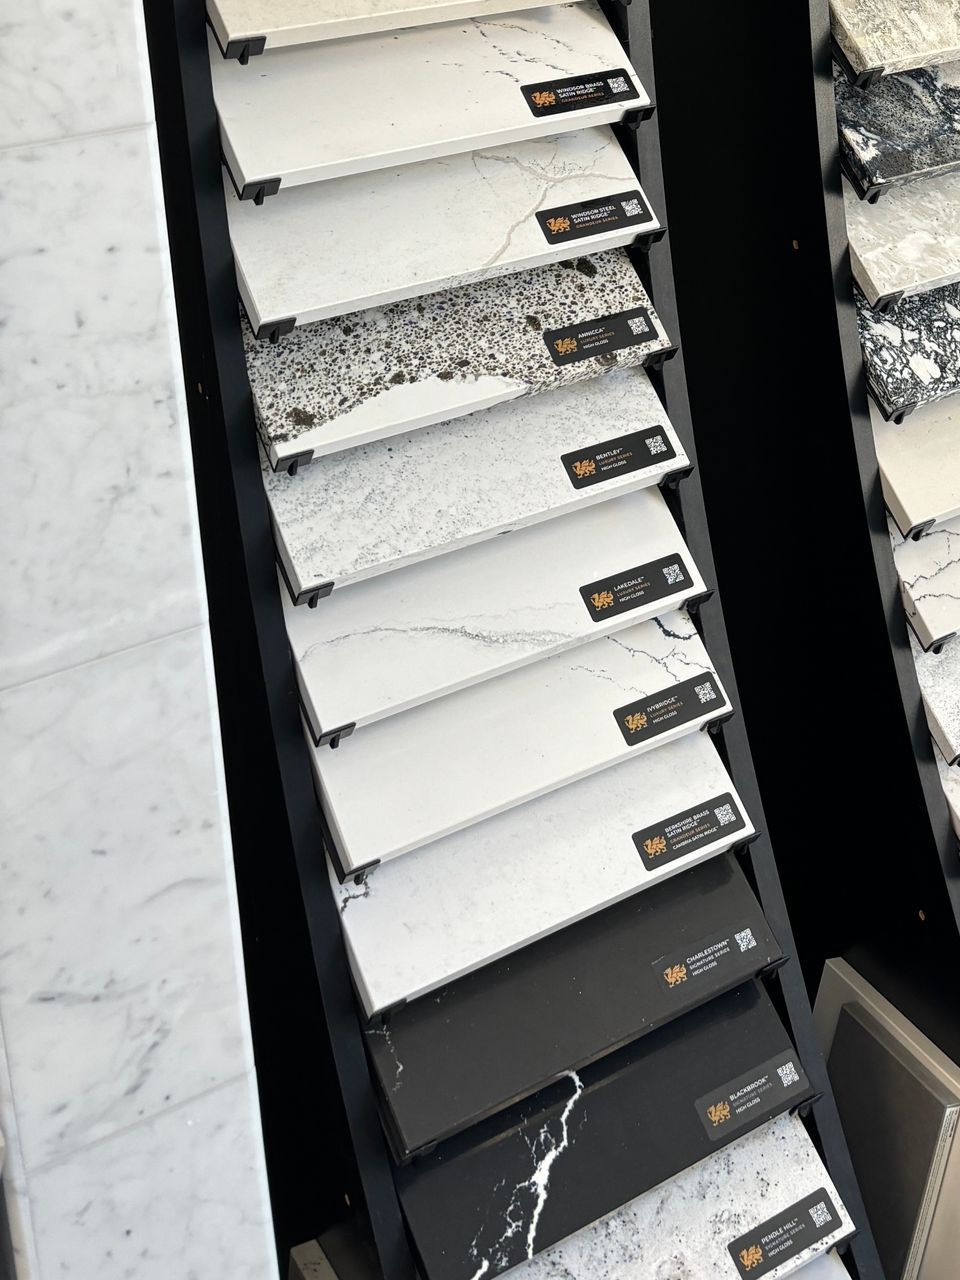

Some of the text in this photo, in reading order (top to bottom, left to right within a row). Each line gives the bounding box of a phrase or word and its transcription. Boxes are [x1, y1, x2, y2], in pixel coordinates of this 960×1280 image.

[556, 84, 584, 94] WINDSOR
[559, 91, 575, 99] SATIN
[571, 209, 599, 219] WINDSOR
[573, 216, 590, 224] SATIN
[613, 460, 627, 468] GLOSS
[665, 711, 677, 719] GLOSS
[665, 810, 710, 833] BERKSHIRE BRASS
[666, 828, 682, 838] SATIN
[673, 839, 692, 850] CAMBRIA
[692, 832, 704, 841] SATIN
[689, 947, 730, 970] SIGNATURE SERIES
[692, 961, 718, 976] HIGH GLOSS
[758, 1082, 773, 1093] SERIES
[735, 1097, 760, 1114] HIGH GLOSS
[761, 1228, 784, 1244] PENDLE
[765, 1223, 806, 1250] SIGNATURE SERIES
[768, 1239, 793, 1257] HIGH GLOSS
